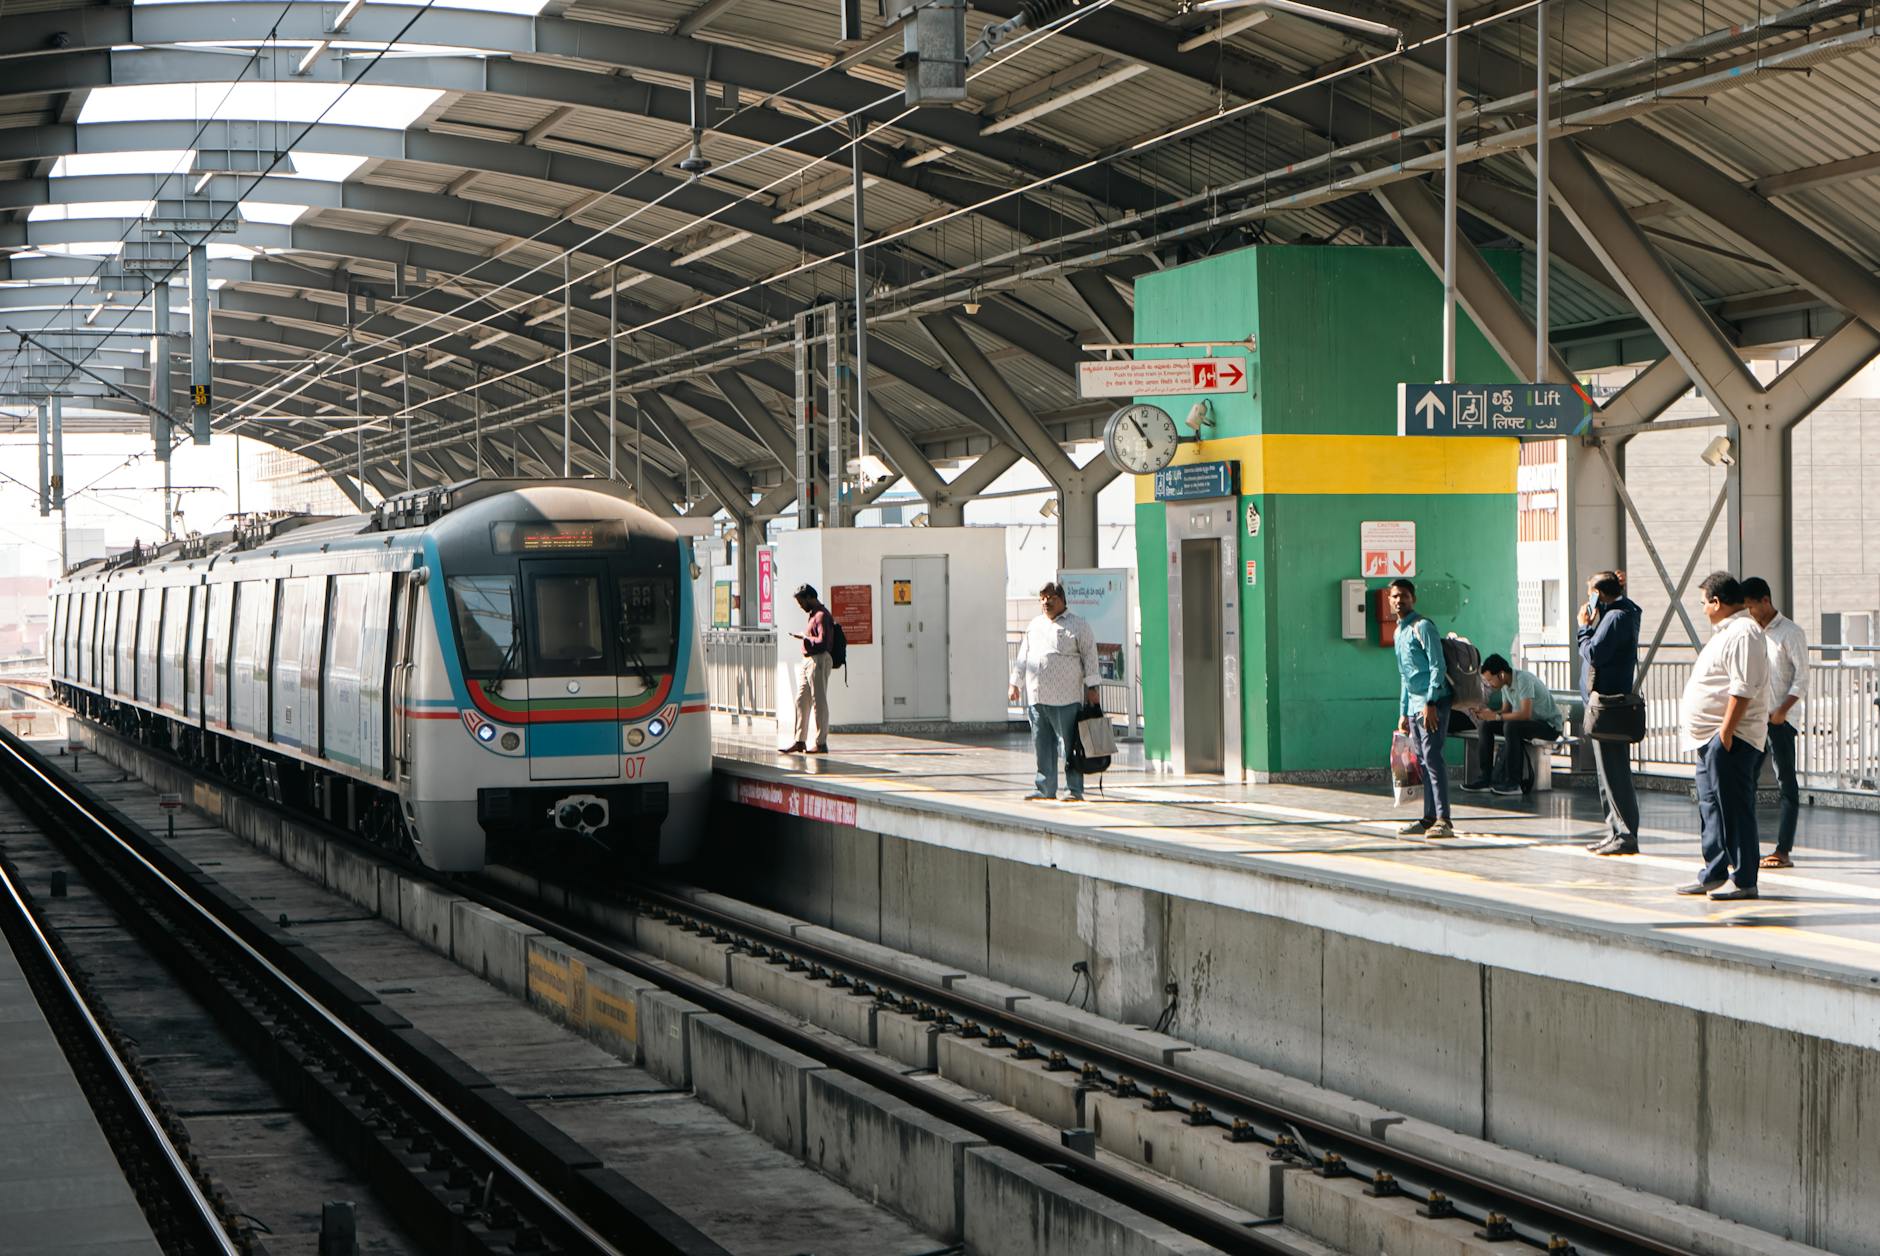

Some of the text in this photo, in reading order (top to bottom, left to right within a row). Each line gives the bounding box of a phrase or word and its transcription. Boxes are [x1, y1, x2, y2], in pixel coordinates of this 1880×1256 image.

[1535, 390, 1561, 406] Lift
[1141, 410, 1148, 418] 12
[1492, 413, 1525, 429] लिफ्ट
[1122, 423, 1128, 431] 10
[1164, 423, 1169, 431] 2
[1168, 435, 1173, 443] 3
[1163, 448, 1169, 456] 4
[1130, 457, 1136, 465] 7
[1156, 457, 1161, 466] 5
[1219, 465, 1224, 492] 1
[625, 757, 645, 779] 07
